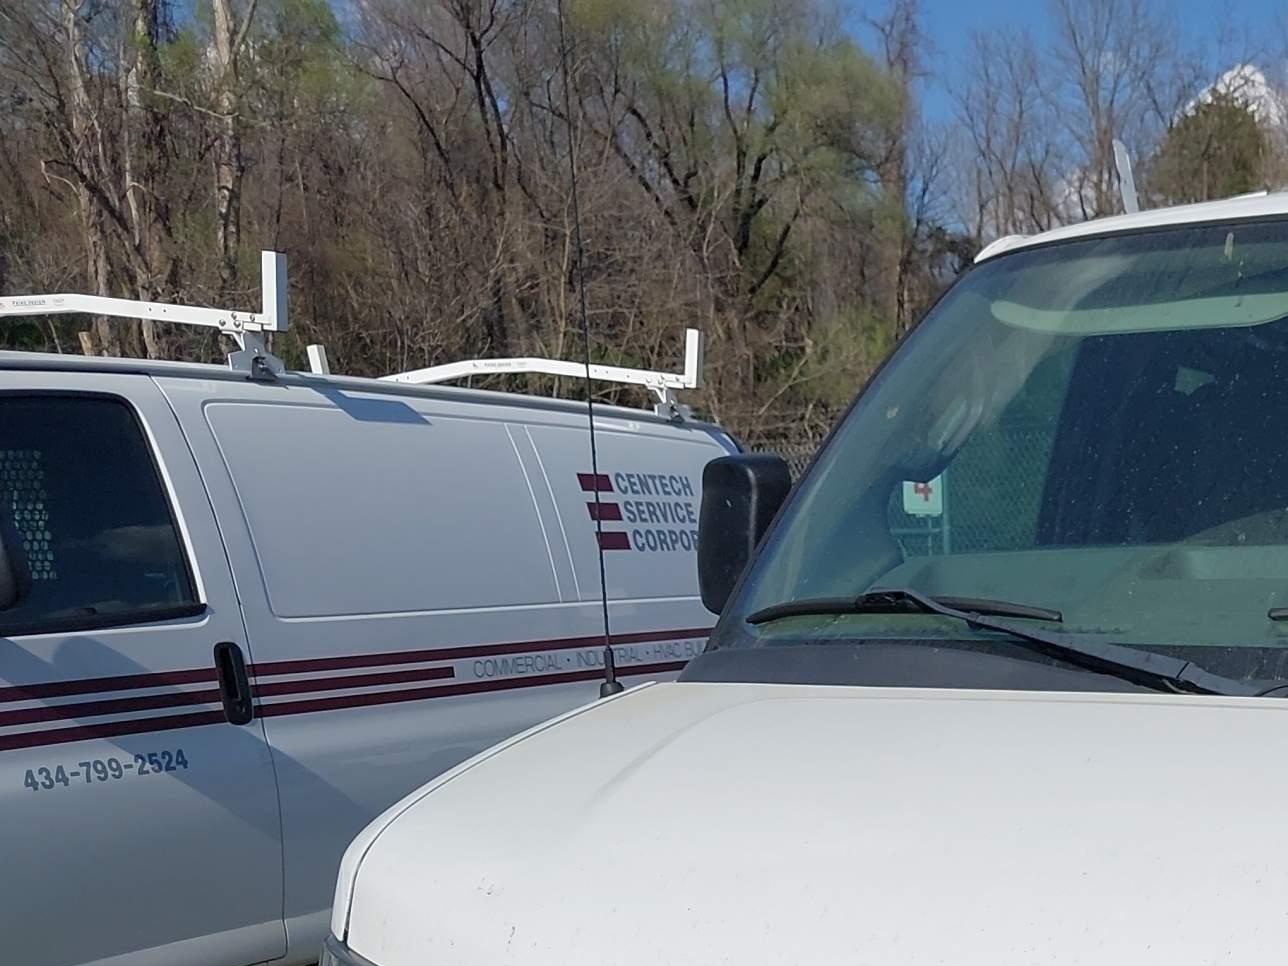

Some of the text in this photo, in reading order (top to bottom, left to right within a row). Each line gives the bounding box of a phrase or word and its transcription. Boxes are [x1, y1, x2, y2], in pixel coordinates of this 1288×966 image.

[614, 472, 694, 496] CENTECH
[623, 500, 698, 524] SERVICE
[473, 655, 561, 677] COMMERCIAL
[577, 648, 642, 667] INDUTRIAL
[653, 642, 682, 659] HVAC
[24, 749, 189, 791] 434-799-2524
